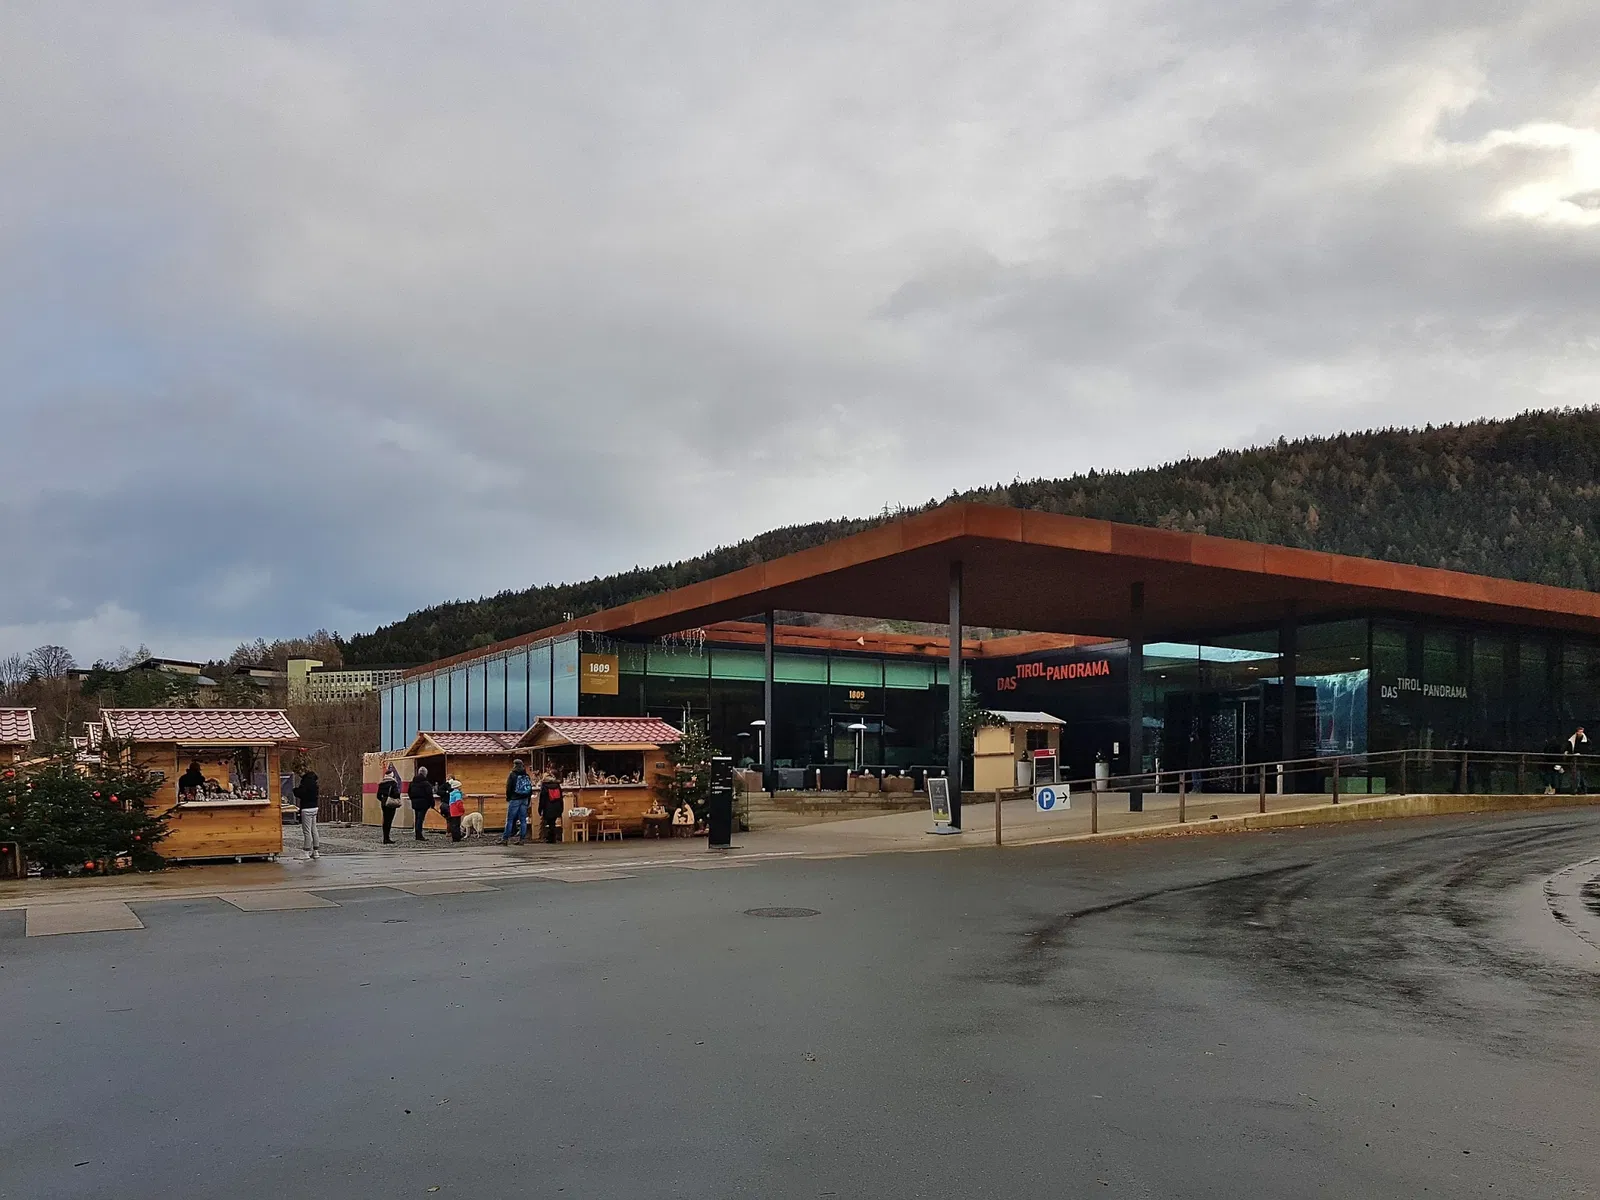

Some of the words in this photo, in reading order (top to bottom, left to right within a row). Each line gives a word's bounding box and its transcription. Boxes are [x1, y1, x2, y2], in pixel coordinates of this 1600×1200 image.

[590, 663, 610, 673] 1809
[997, 677, 1017, 691] DAS
[1016, 662, 1046, 678] TIROL
[1047, 660, 1110, 680] PANORAMA
[849, 690, 865, 699] 1809
[1381, 685, 1398, 698] DAS
[1397, 677, 1421, 691] TIROL
[1423, 684, 1467, 698] PANORAMA
[1043, 791, 1052, 808] P
